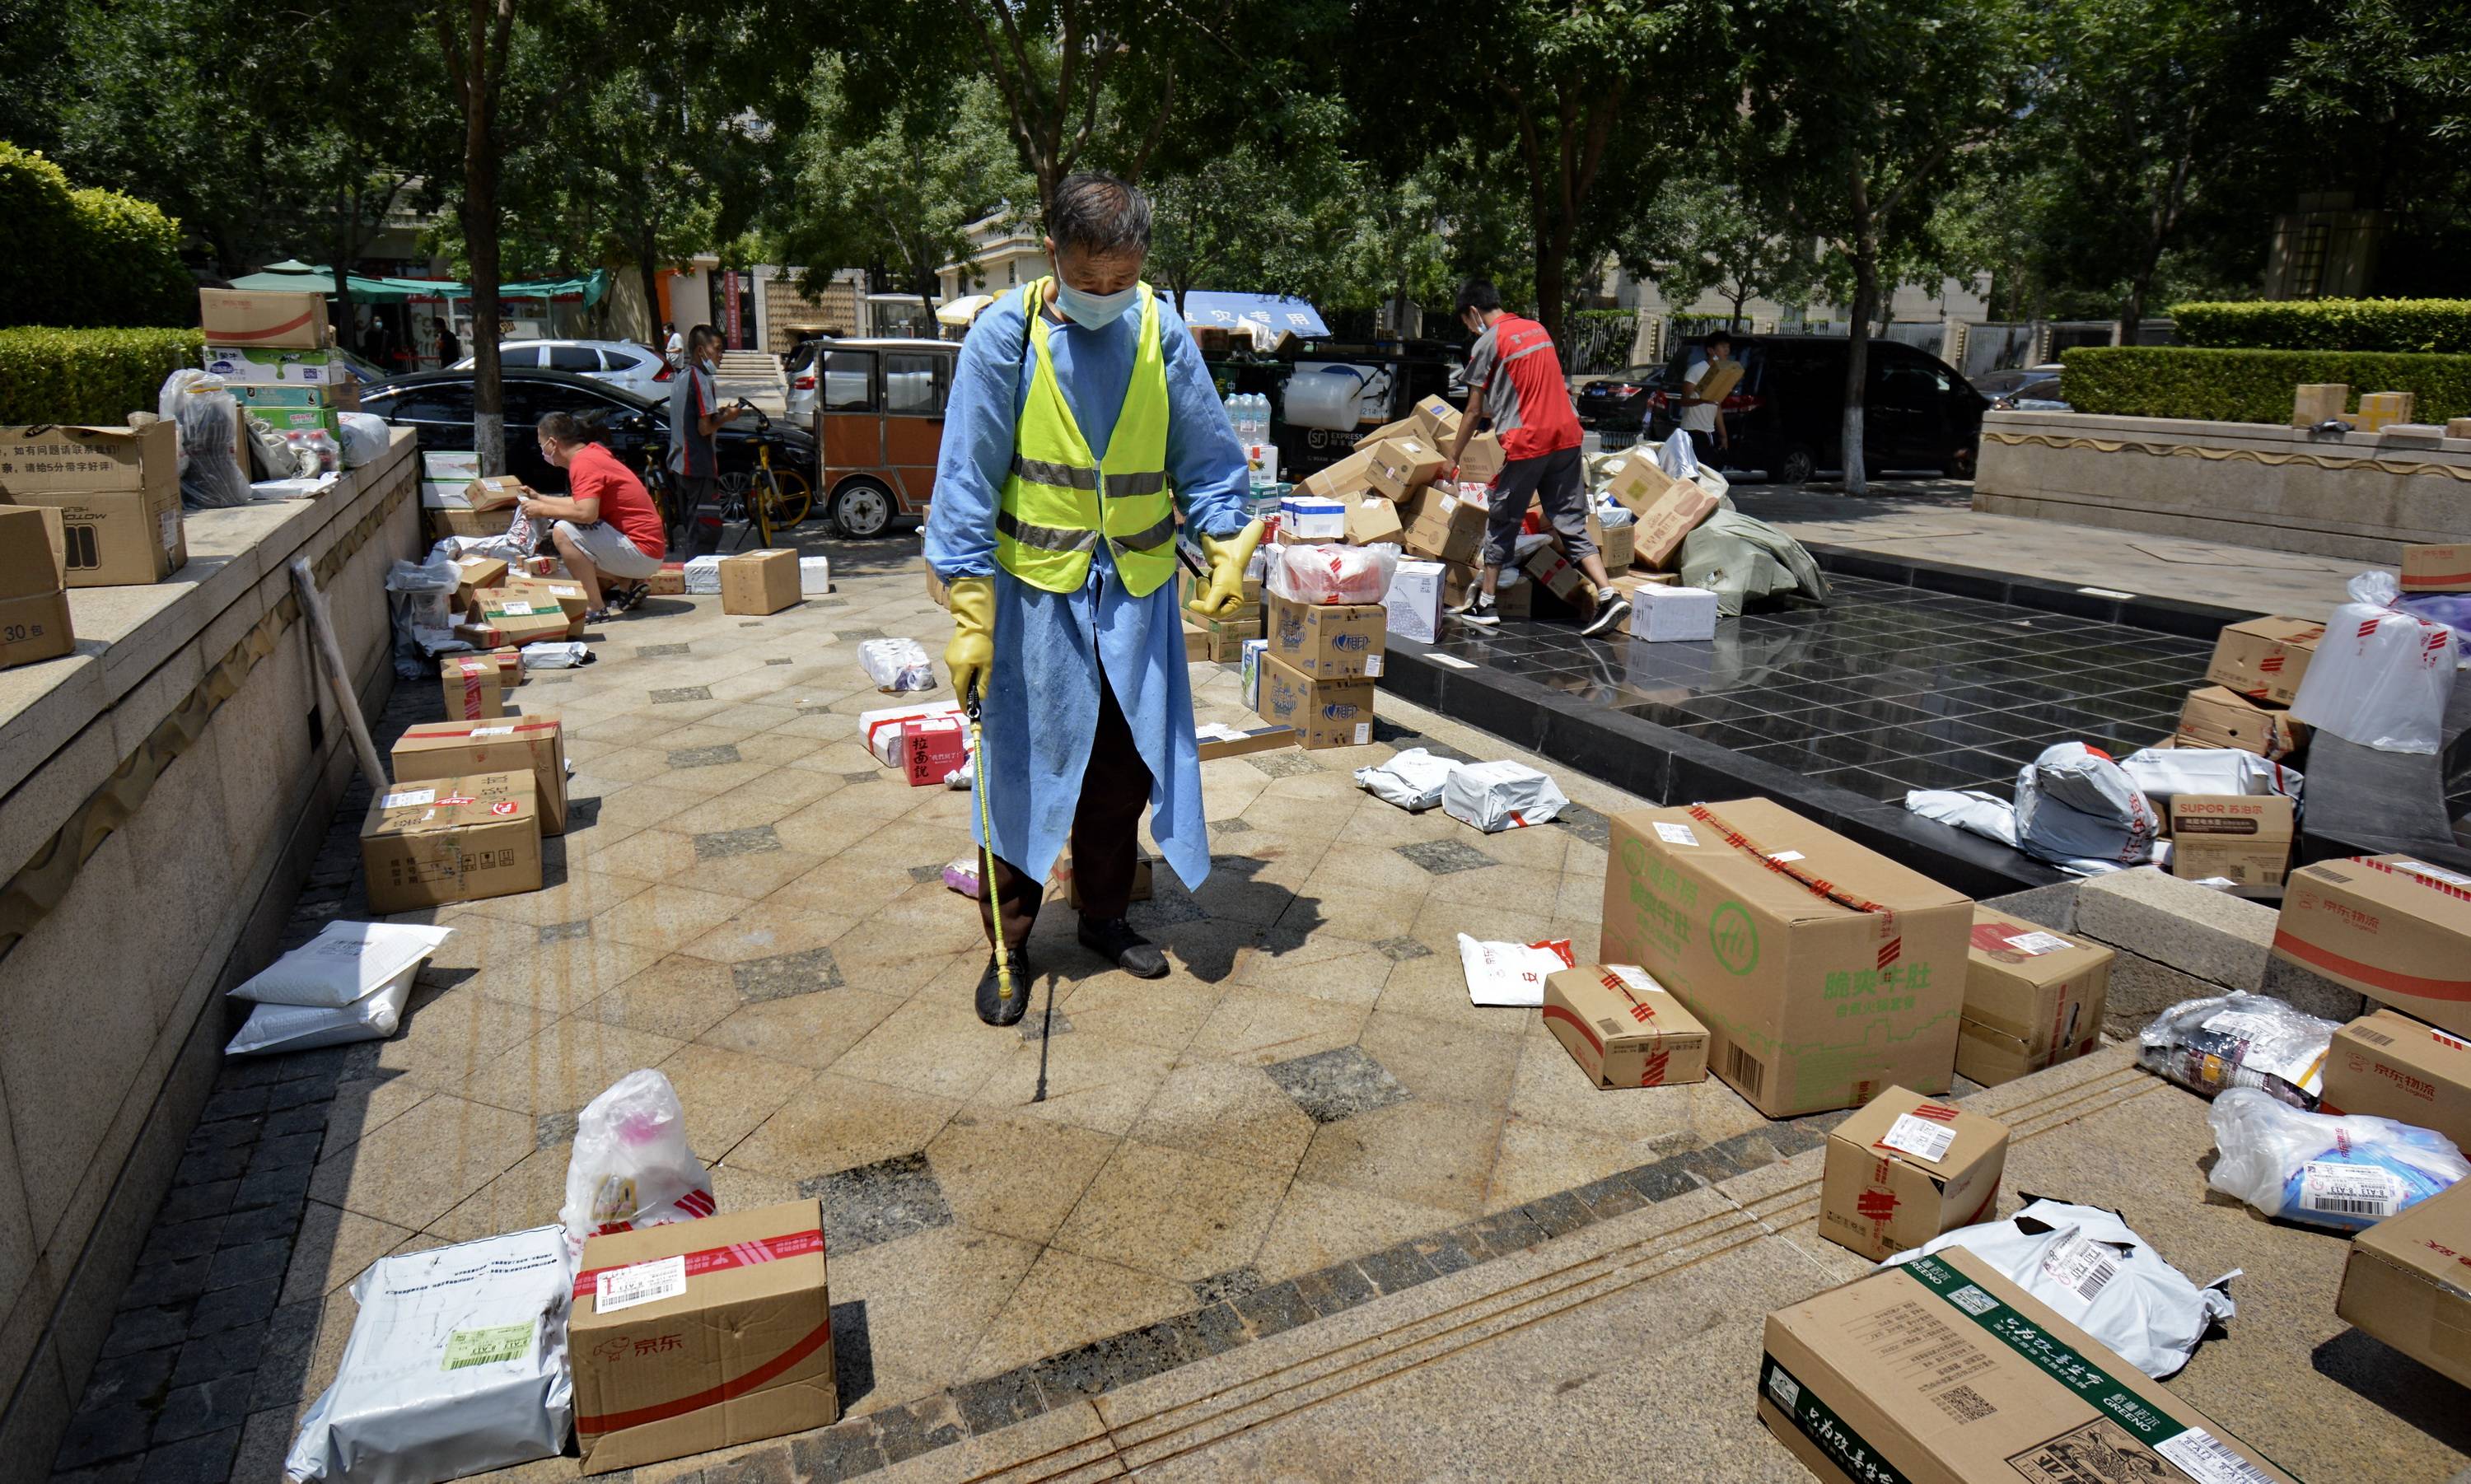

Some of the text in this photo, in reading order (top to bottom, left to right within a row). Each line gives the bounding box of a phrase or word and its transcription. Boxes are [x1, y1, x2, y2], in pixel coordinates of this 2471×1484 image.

[1331, 432, 1364, 441] EXPRESS
[4, 624, 44, 642] 30 包
[2179, 804, 2263, 814] SUPOR 苏泊尔
[2323, 899, 2380, 929] 京东物流
[1823, 961, 1932, 1000] 脆爽牛肚
[2375, 1062, 2436, 1096] 京东物流
[2405, 1086, 2434, 1102] Logistics
[2330, 1186, 2385, 1197] 8-A13 8-A13
[633, 1333, 684, 1357] 京东
[2102, 1398, 2151, 1432] GREENO
